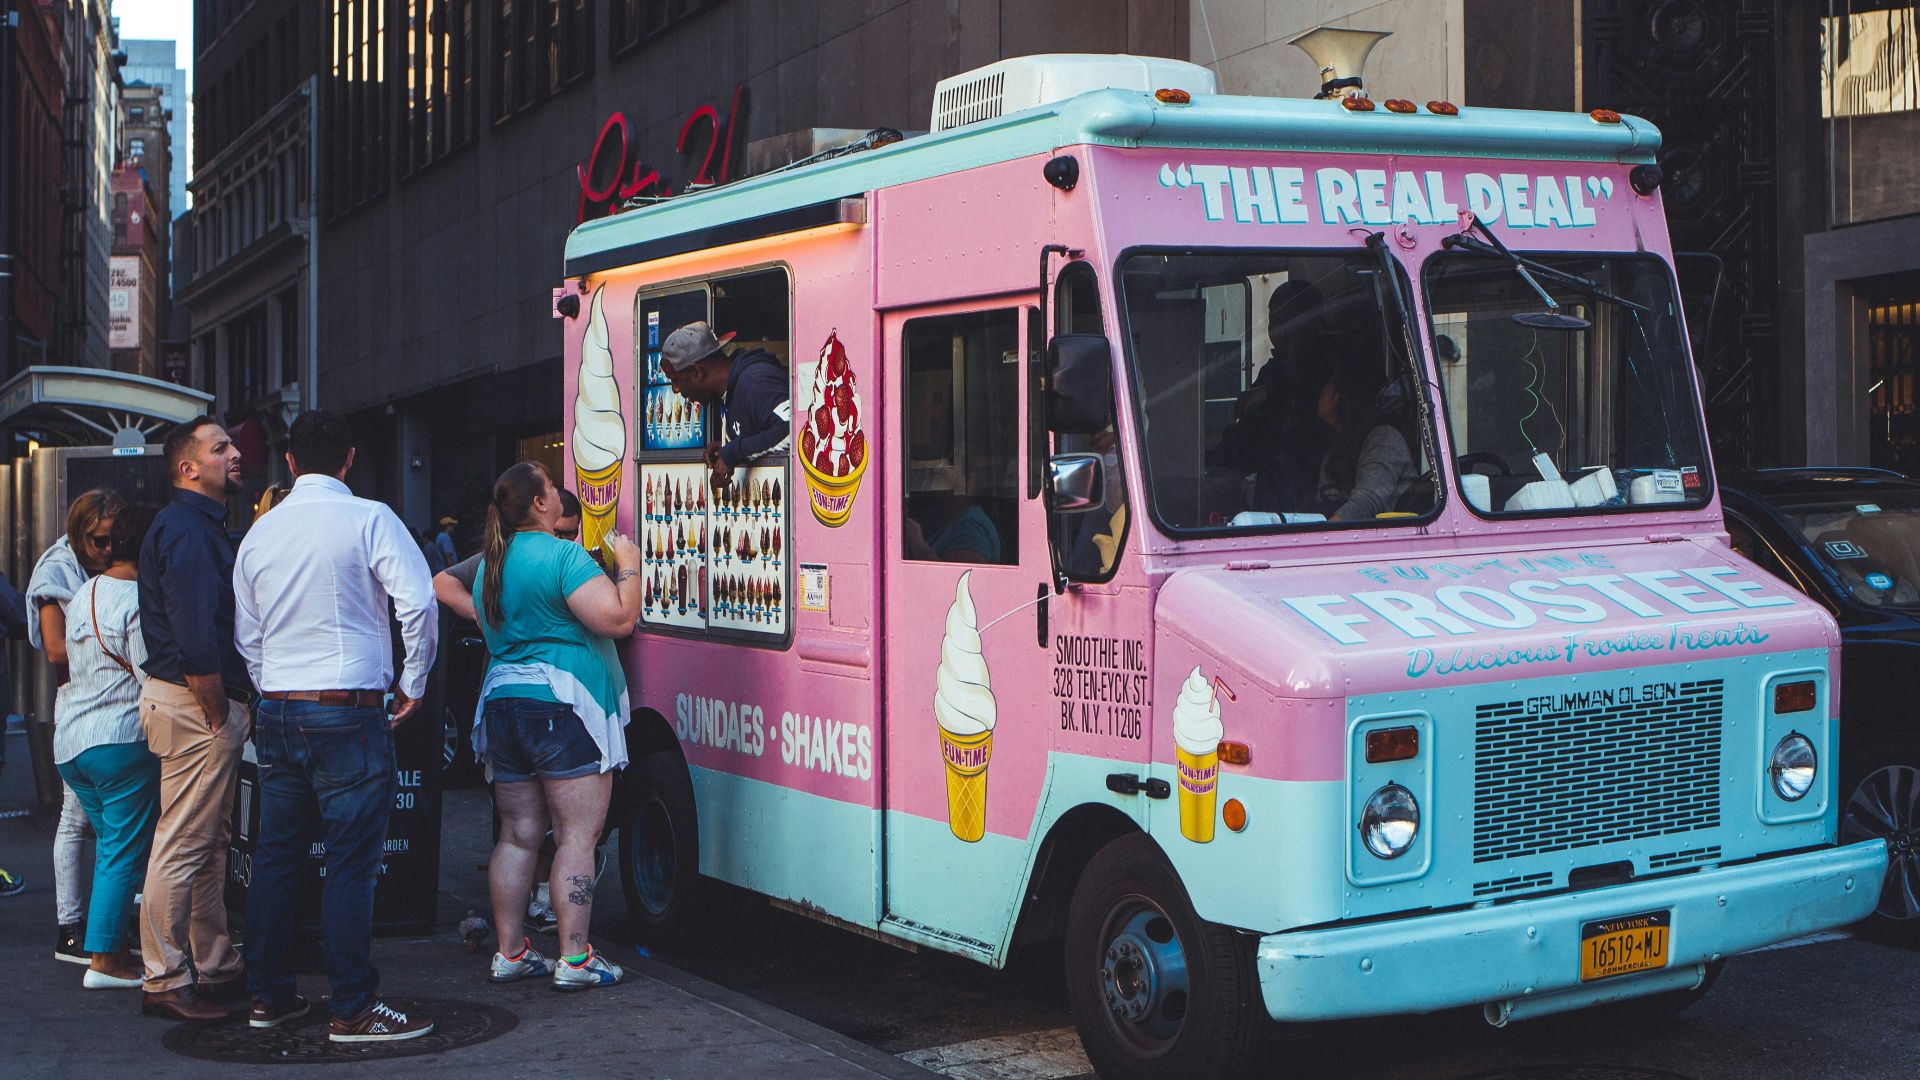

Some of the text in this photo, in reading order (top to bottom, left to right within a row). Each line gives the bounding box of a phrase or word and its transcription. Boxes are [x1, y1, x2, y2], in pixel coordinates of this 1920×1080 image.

[1315, 167, 1459, 226] REAL
[580, 477, 618, 506] FUN-TIME
[811, 486, 851, 513] FUN-TIME
[1360, 552, 1614, 585] FUN-TIME
[1282, 565, 1797, 645] FROSTEE
[1056, 635, 1147, 672] SMOOTHIE INC.
[1405, 620, 1770, 679] Delicious Frostee Treats
[1053, 668, 1073, 699] 328
[1132, 674, 1153, 707] ST.
[1526, 681, 1676, 715] GRUMMAN OLSON
[676, 692, 872, 782] SUNDAES SHAKES
[1061, 701, 1142, 740] BK. N.Y. 11206
[943, 740, 988, 768] FUN-TIME
[1178, 760, 1216, 781] FUN-TIME
[396, 793, 414, 809] 30
[1180, 777, 1215, 794] MILKSHAKE
[382, 839, 409, 852] ARDEN
[230, 846, 252, 888] TRAS
[1604, 918, 1649, 933] NEW YORK
[1592, 928, 1663, 969] 16519 MJ
[1602, 961, 1649, 975] COMMERCIAL
